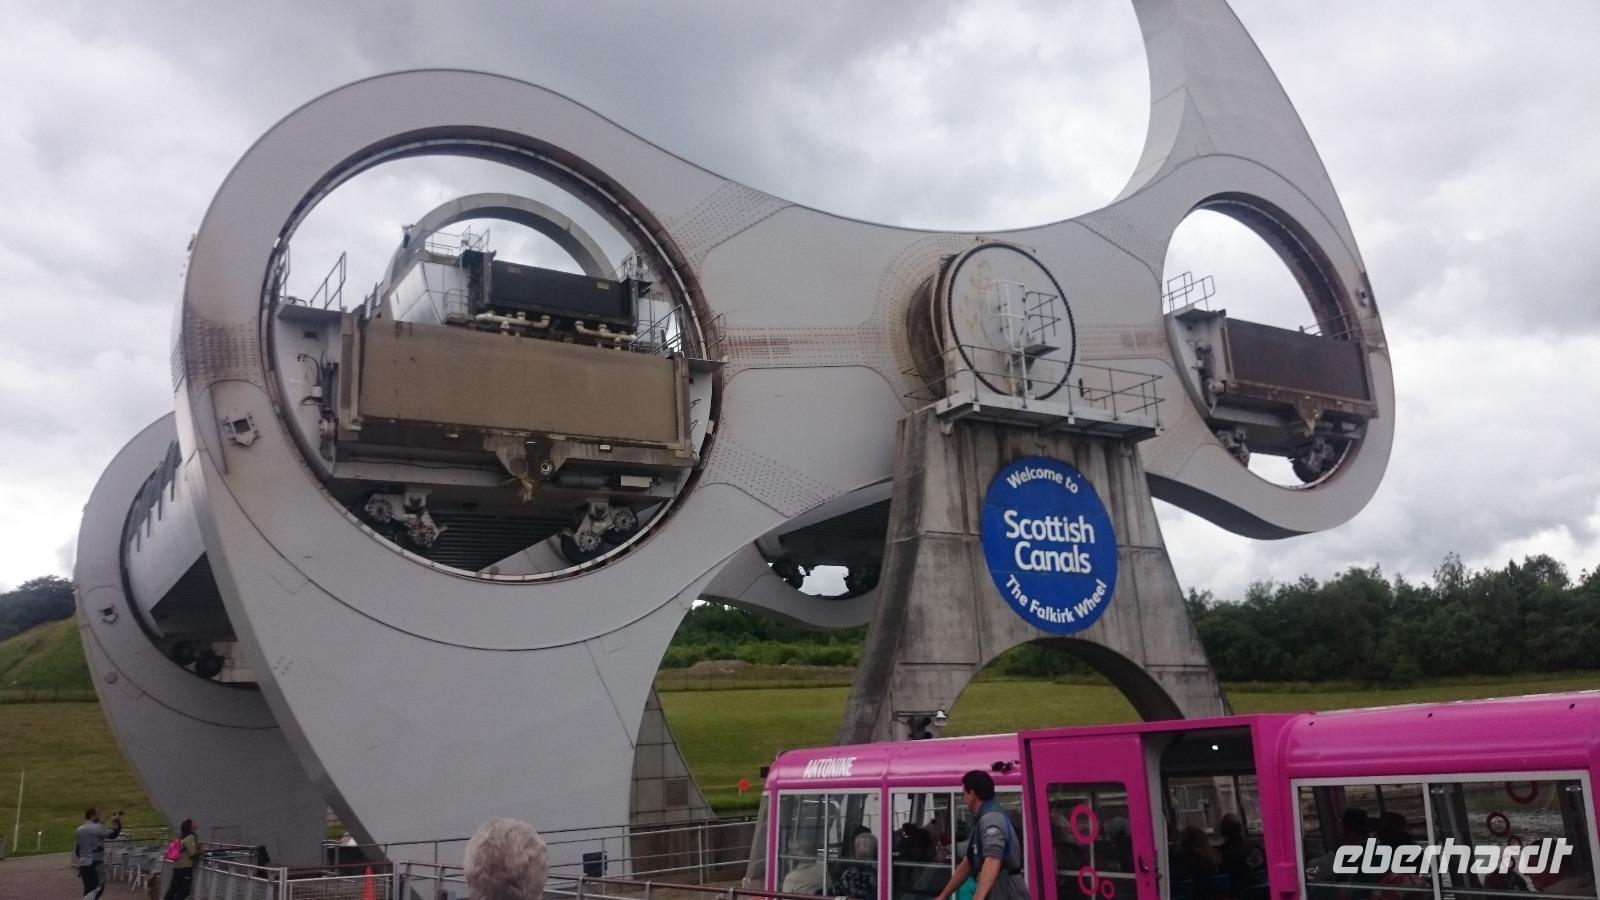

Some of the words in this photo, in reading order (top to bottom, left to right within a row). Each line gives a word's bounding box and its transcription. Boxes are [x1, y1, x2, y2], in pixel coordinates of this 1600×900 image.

[1006, 466, 1063, 489] Welcome
[1065, 477, 1079, 494] to
[1003, 509, 1096, 544] Scottish
[1014, 541, 1092, 574] Canals
[1005, 574, 1028, 606] The
[1029, 599, 1075, 623] Falkirk
[1073, 579, 1107, 619] Wheel
[803, 755, 857, 779] ANTONINE
